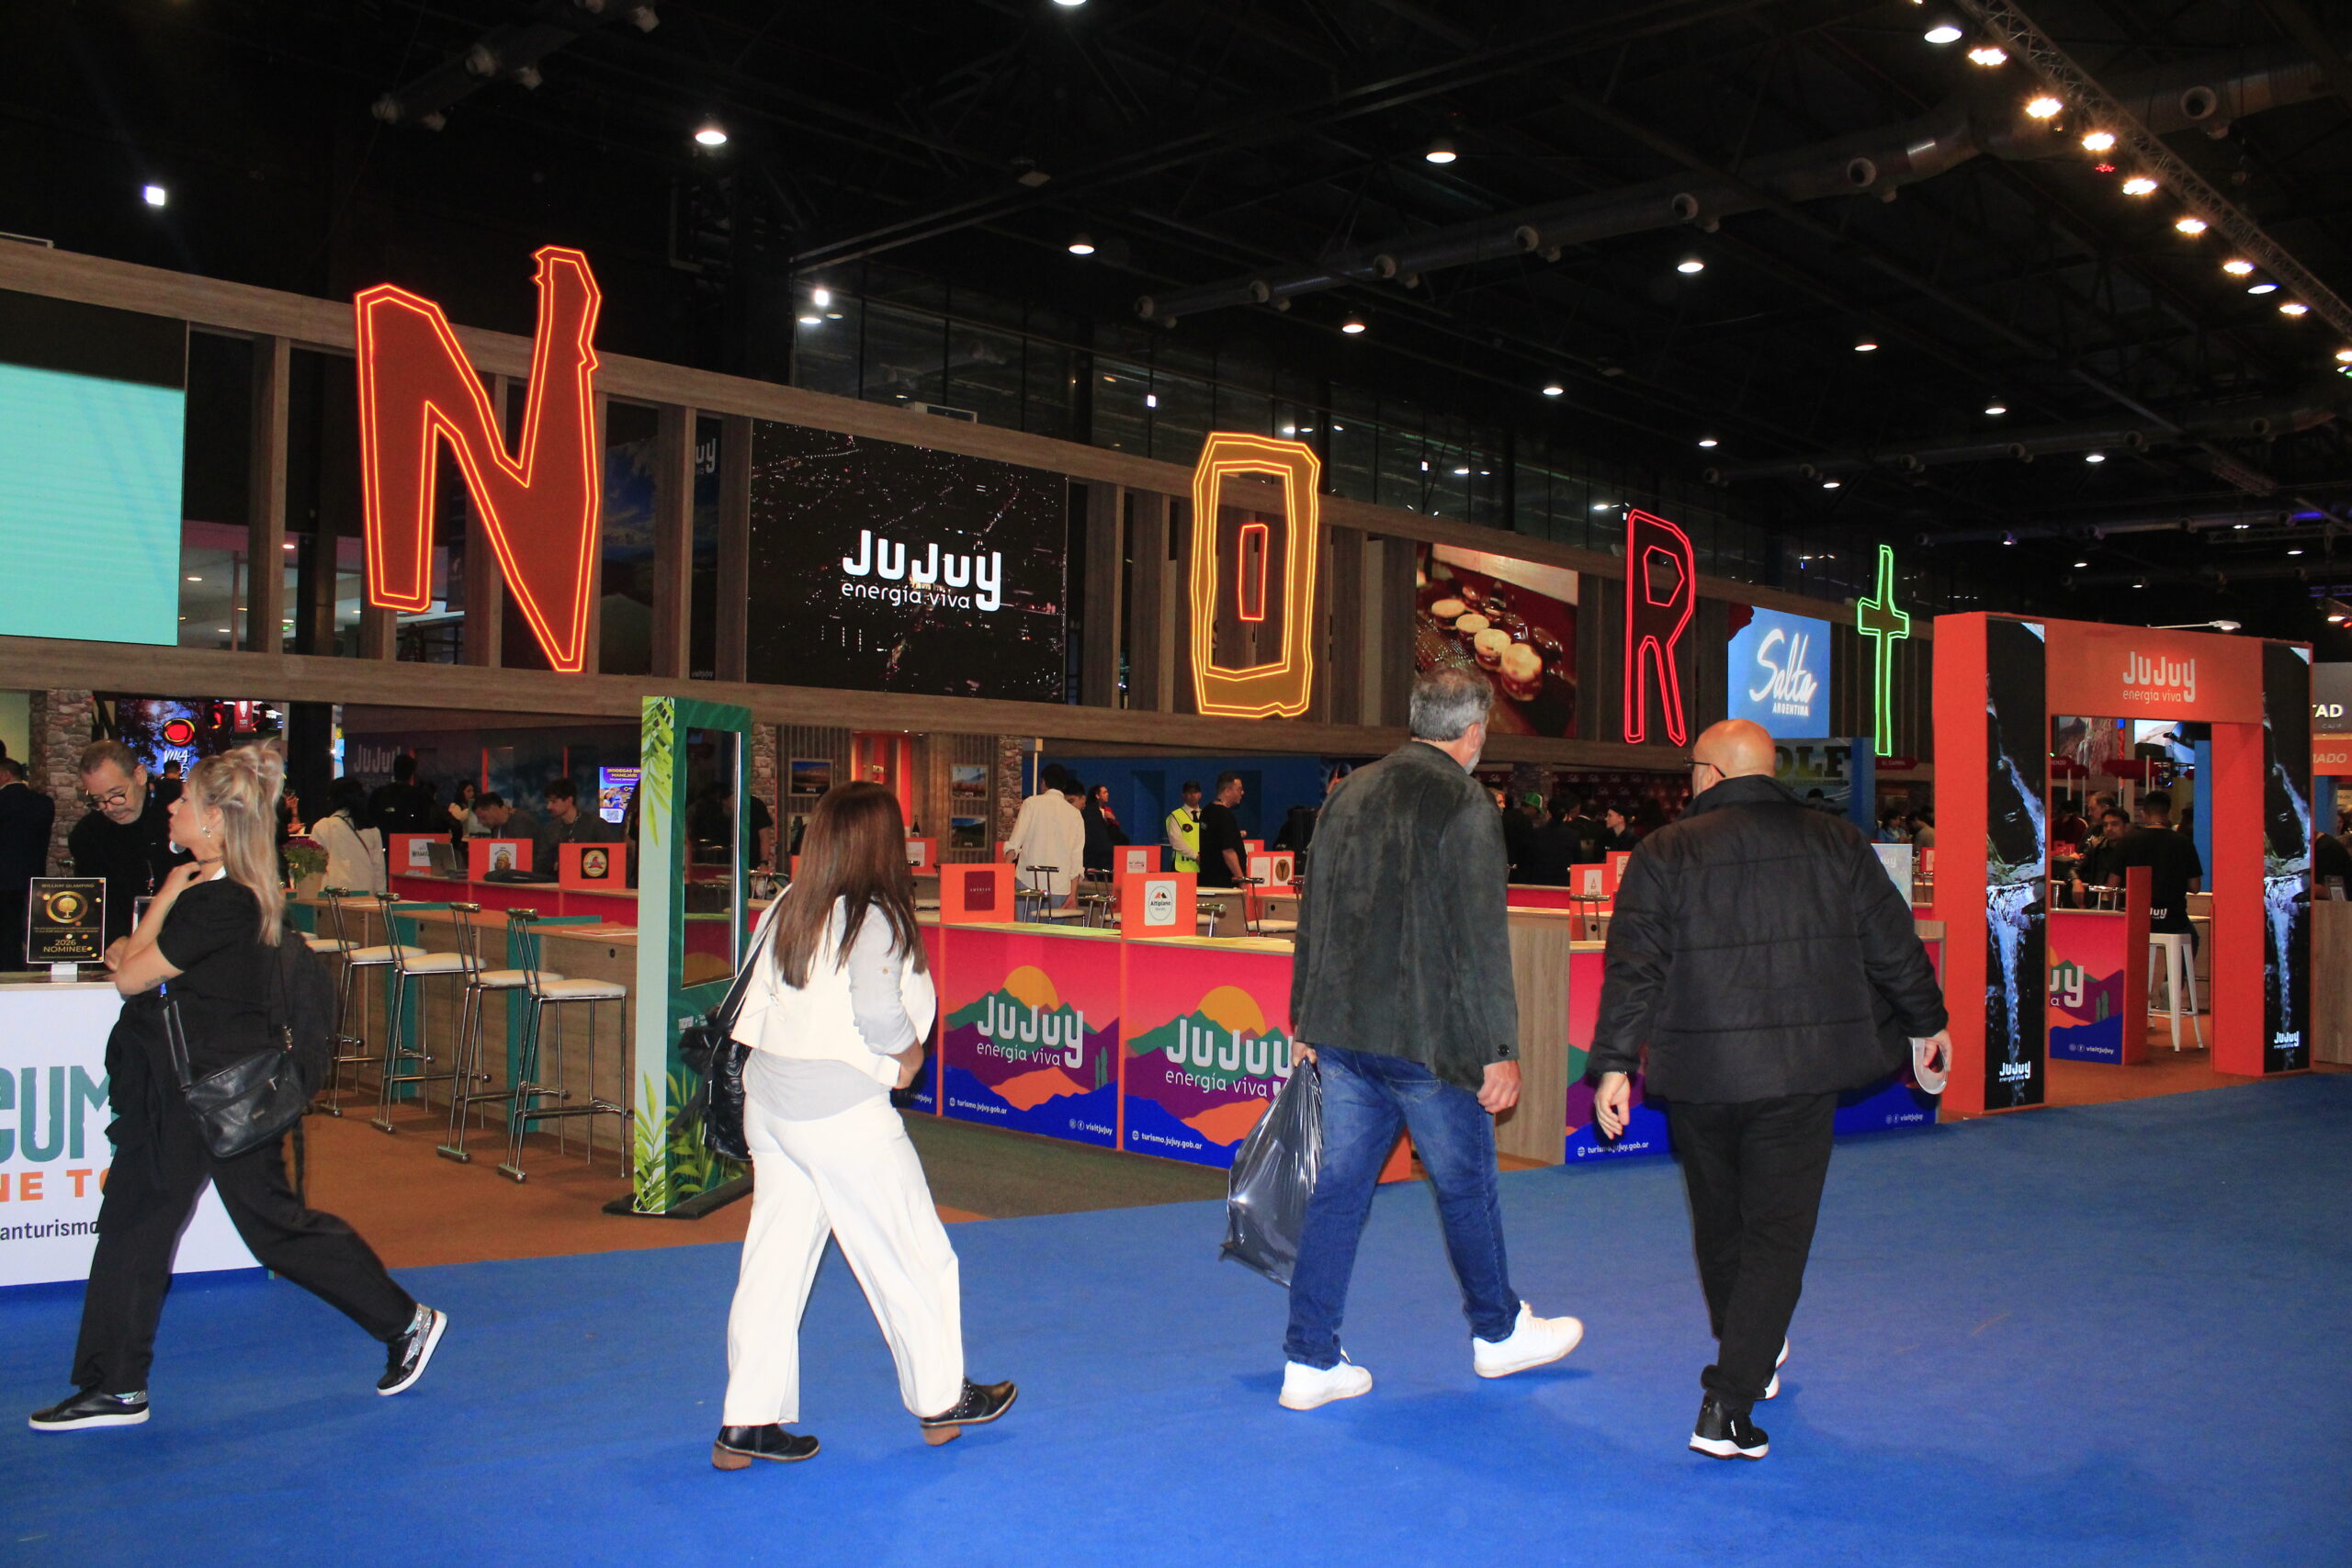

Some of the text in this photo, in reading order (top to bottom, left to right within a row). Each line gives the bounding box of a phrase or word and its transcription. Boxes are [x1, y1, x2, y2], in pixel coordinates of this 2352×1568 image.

[842, 581, 970, 609] energía viva
[1749, 628, 1818, 703] Salta
[2122, 688, 2181, 705] energía viva
[1772, 702, 1809, 716] ARGENTINA
[164, 750, 189, 762] VILLA
[977, 1043, 1060, 1066] energía viva
[2086, 1045, 2115, 1055] visitjujuy
[1165, 1070, 1267, 1098] energía viva
[957, 1099, 1007, 1115] turismo.jujuy.gob.ar
[1085, 1122, 1114, 1136] visitjujuy
[1141, 1132, 1203, 1150] turismo.jujuy.gob.ar
[1588, 1141, 1649, 1154] turismo.jujuy.gob.ar
